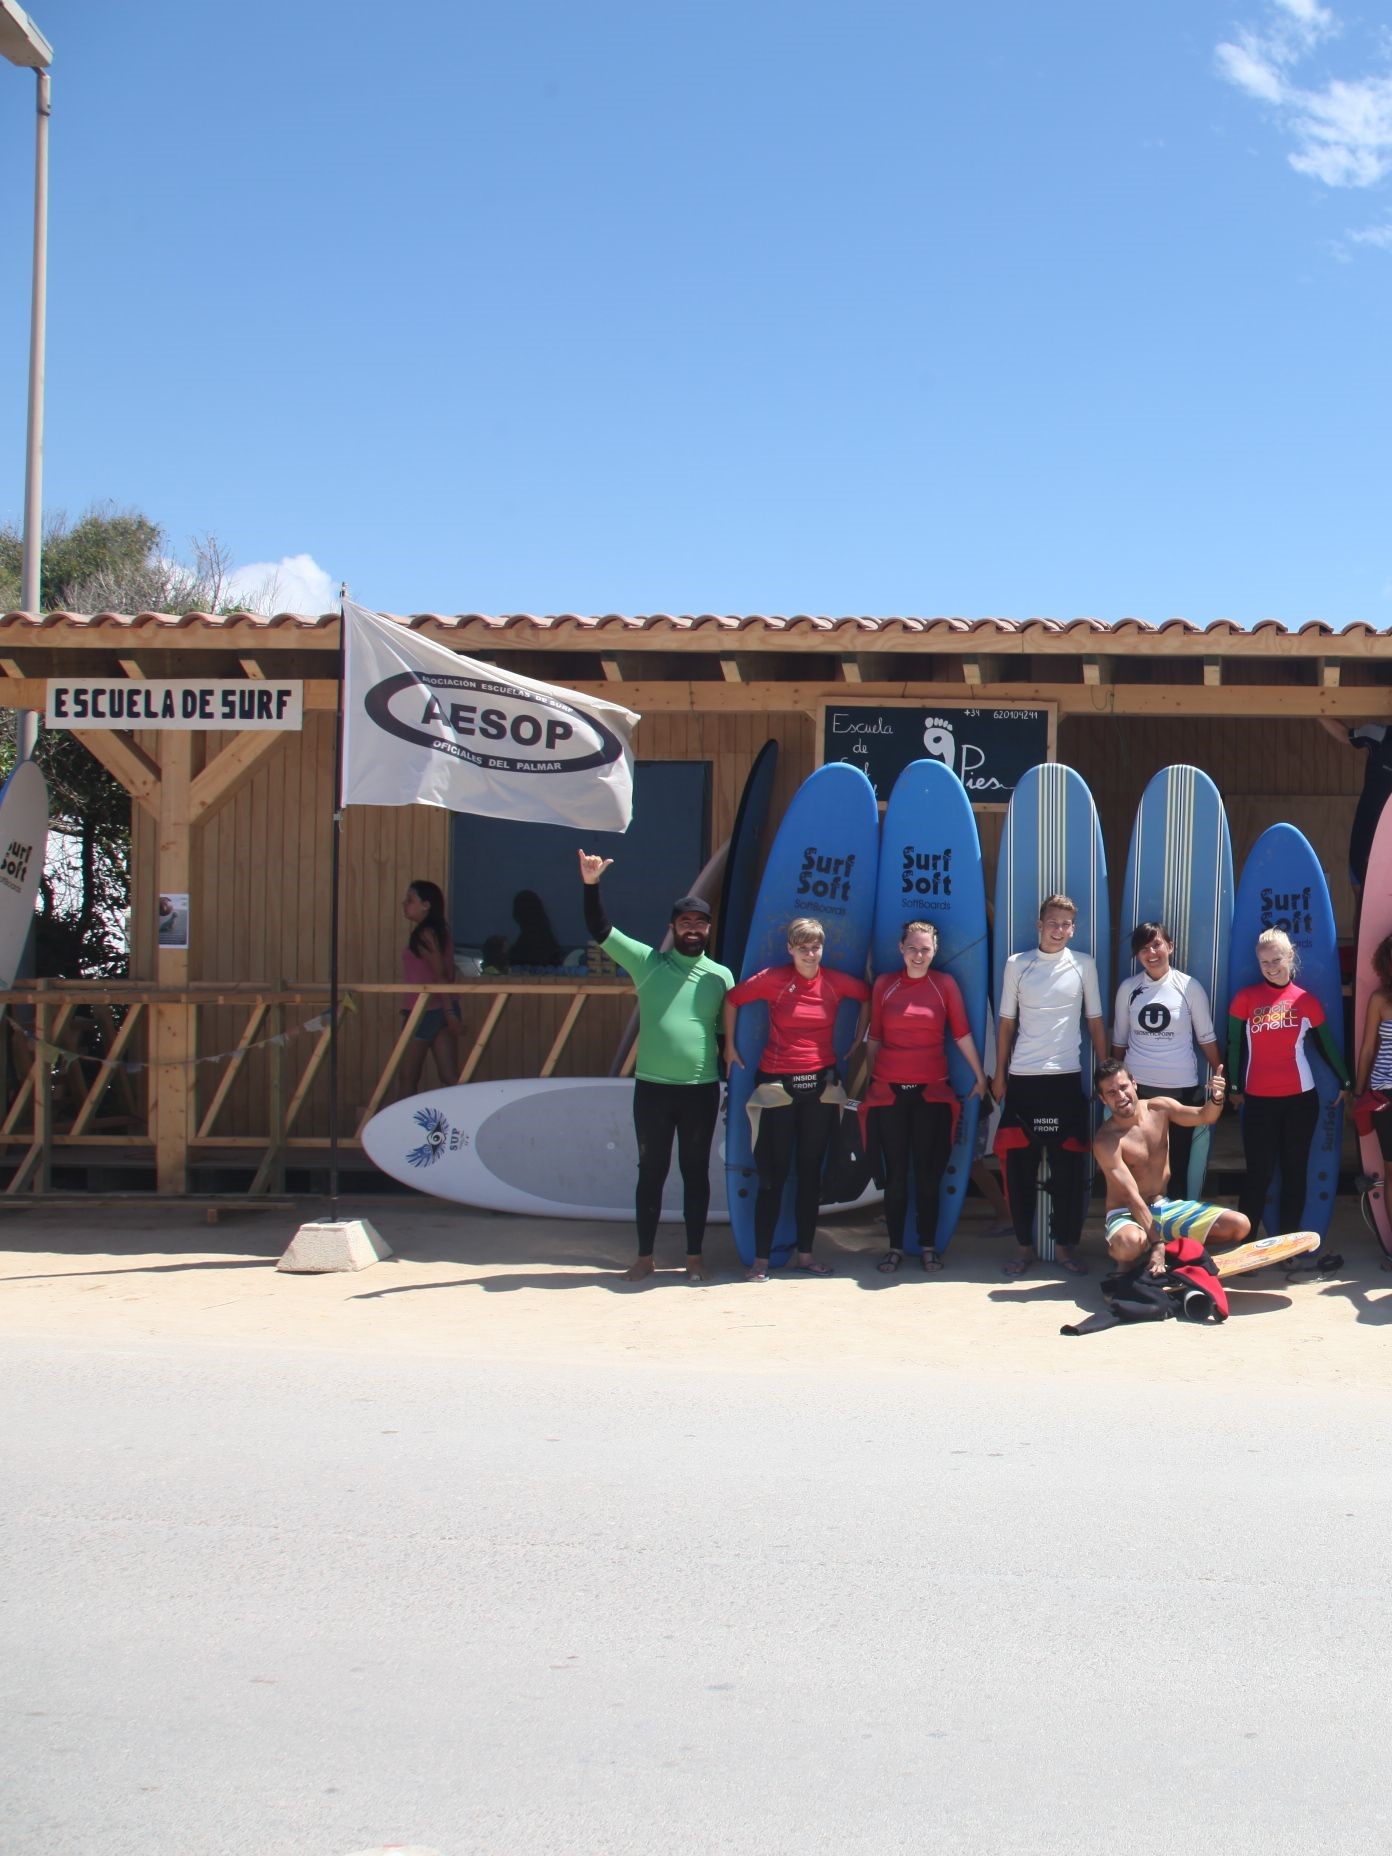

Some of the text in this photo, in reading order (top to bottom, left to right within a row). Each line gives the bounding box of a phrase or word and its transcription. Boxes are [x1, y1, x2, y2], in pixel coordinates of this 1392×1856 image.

[481, 683, 530, 698] ESCUELAS
[54, 688, 292, 720] ESCUELA DE SURF
[964, 709, 980, 717] +34
[421, 694, 574, 750] AESOP
[832, 713, 893, 734] Escuela
[433, 740, 562, 771] OFICIALES DEL PALMAR
[852, 738, 868, 754] de
[801, 847, 856, 877] Surf
[902, 846, 952, 872] Surf
[797, 871, 850, 901] Soft
[902, 870, 952, 896] Soft
[902, 898, 951, 911] SoftBoards
[1260, 886, 1312, 912] Surf
[1033, 1117, 1060, 1125] INSIDE
[449, 1127, 460, 1151] SUP
